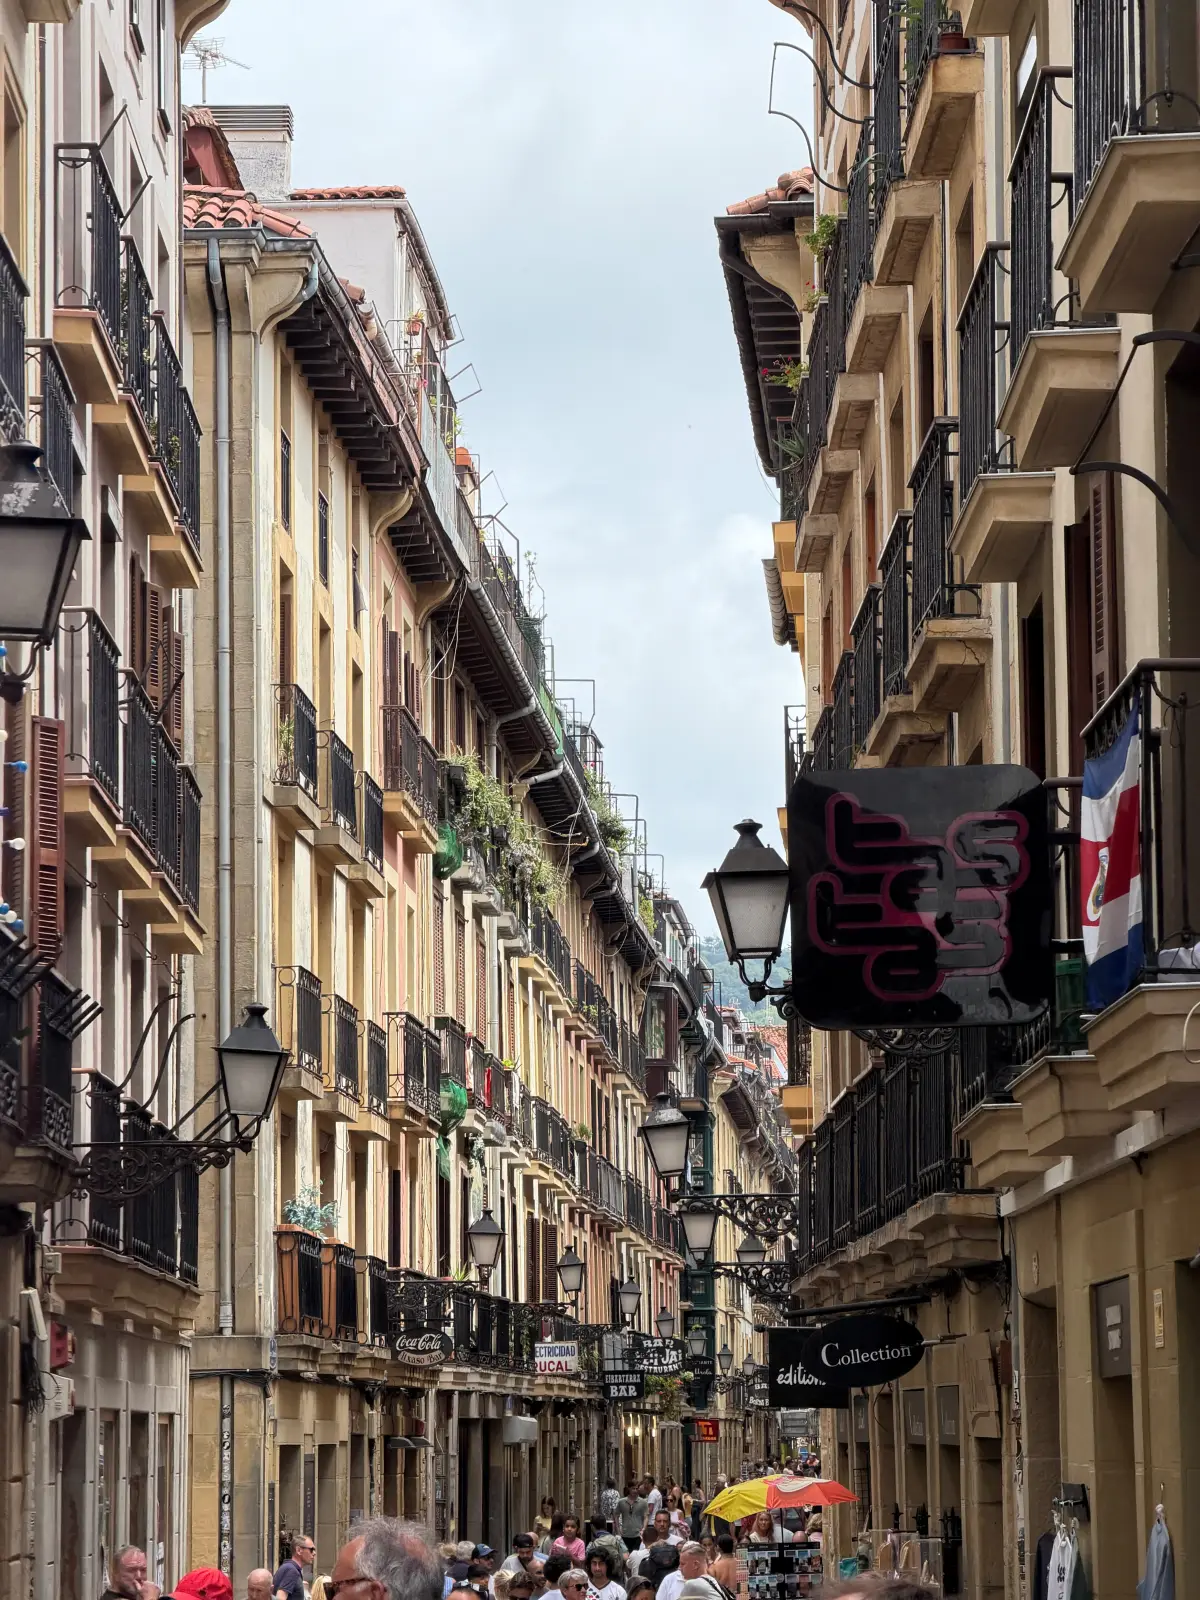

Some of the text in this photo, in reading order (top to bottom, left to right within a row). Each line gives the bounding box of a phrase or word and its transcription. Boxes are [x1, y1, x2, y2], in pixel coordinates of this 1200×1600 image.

[396, 1334, 442, 1351] Coca-Cola
[642, 1338, 673, 1348] BAR
[427, 1352, 443, 1363] Bar
[535, 1345, 576, 1358] ECTRICIDAD
[821, 1343, 912, 1368] Collection
[609, 1385, 638, 1398] BAR
